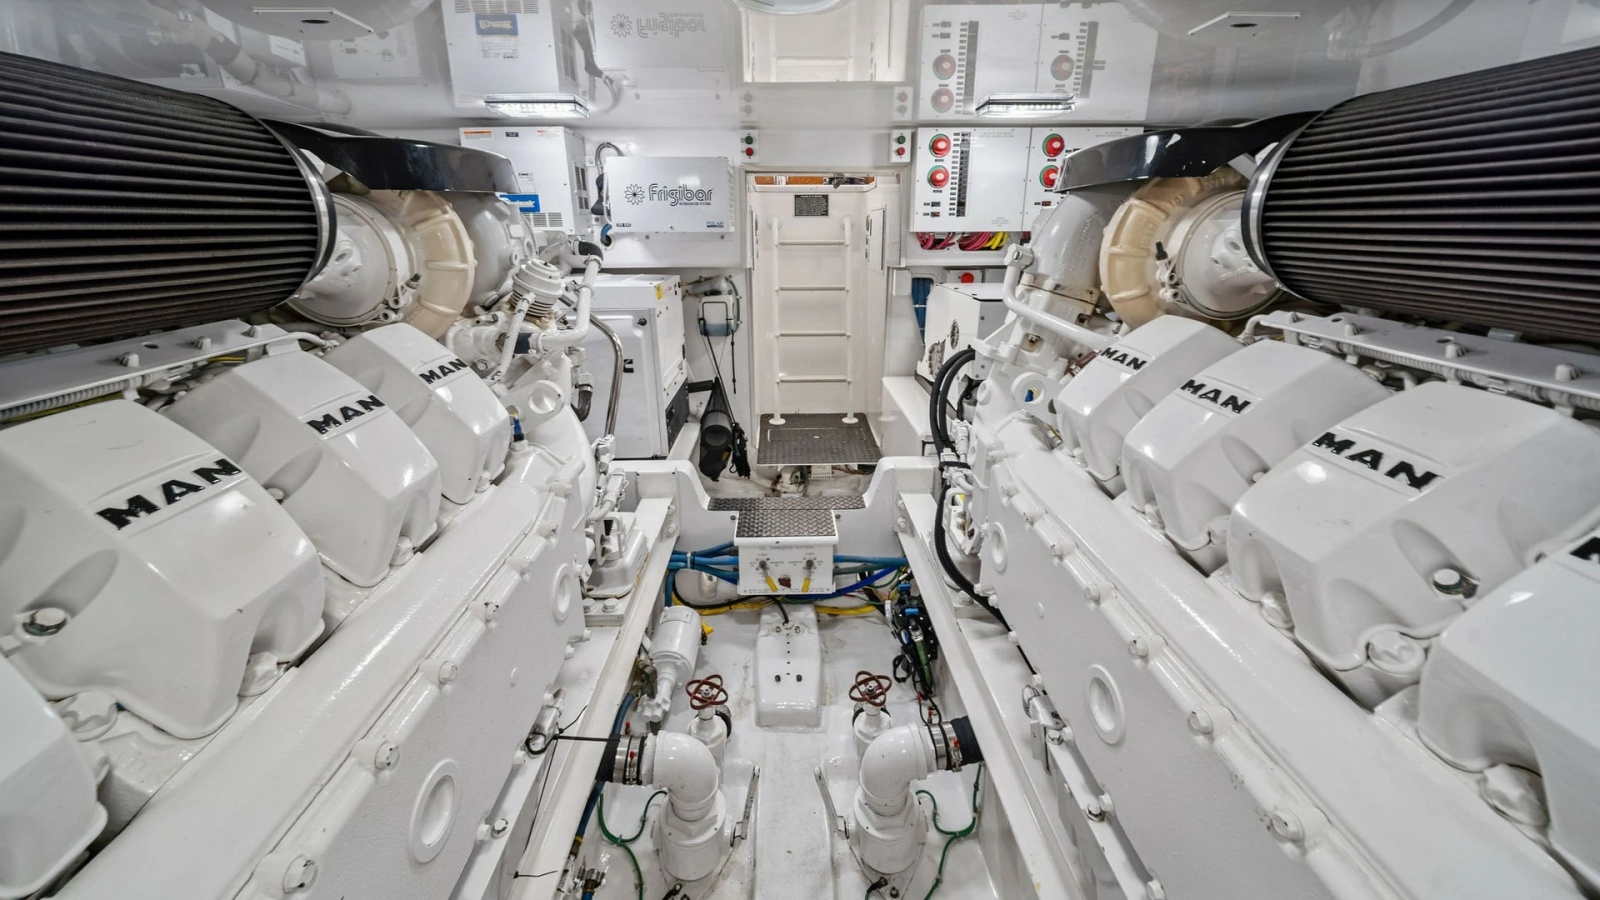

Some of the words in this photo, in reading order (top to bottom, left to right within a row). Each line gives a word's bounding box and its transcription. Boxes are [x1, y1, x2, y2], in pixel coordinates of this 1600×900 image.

[648, 183, 713, 207] Frigibar
[419, 358, 468, 385] MAN
[1100, 347, 1147, 371] MAN
[1180, 379, 1251, 414] MAN
[306, 394, 385, 435] MAN
[1312, 431, 1440, 490] MAN
[95, 458, 242, 531] MAN
